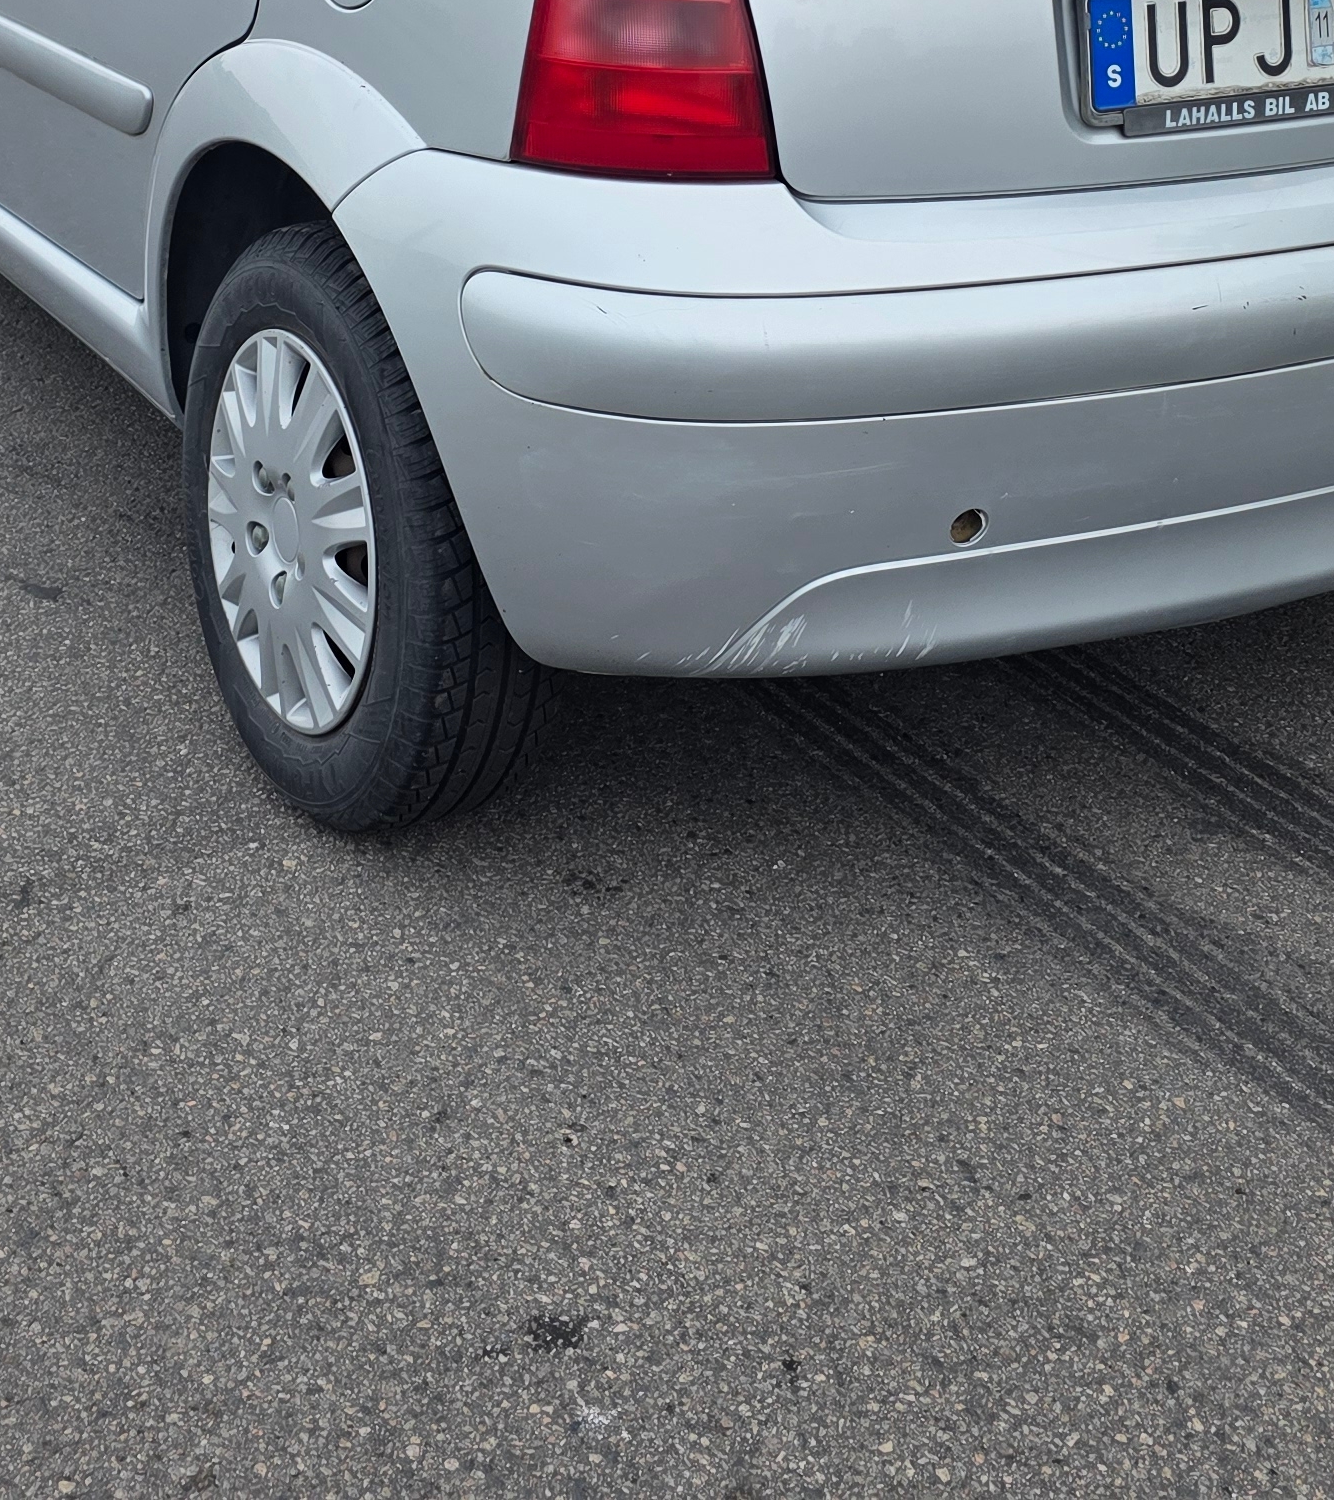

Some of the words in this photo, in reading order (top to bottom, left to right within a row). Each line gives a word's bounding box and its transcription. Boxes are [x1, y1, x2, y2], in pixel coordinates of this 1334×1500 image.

[1315, 11, 1329, 38] 11
[1107, 64, 1122, 88] S
[1165, 100, 1255, 128] LAHALLS
[1265, 97, 1295, 117] BIL
[1305, 91, 1330, 112] AB
